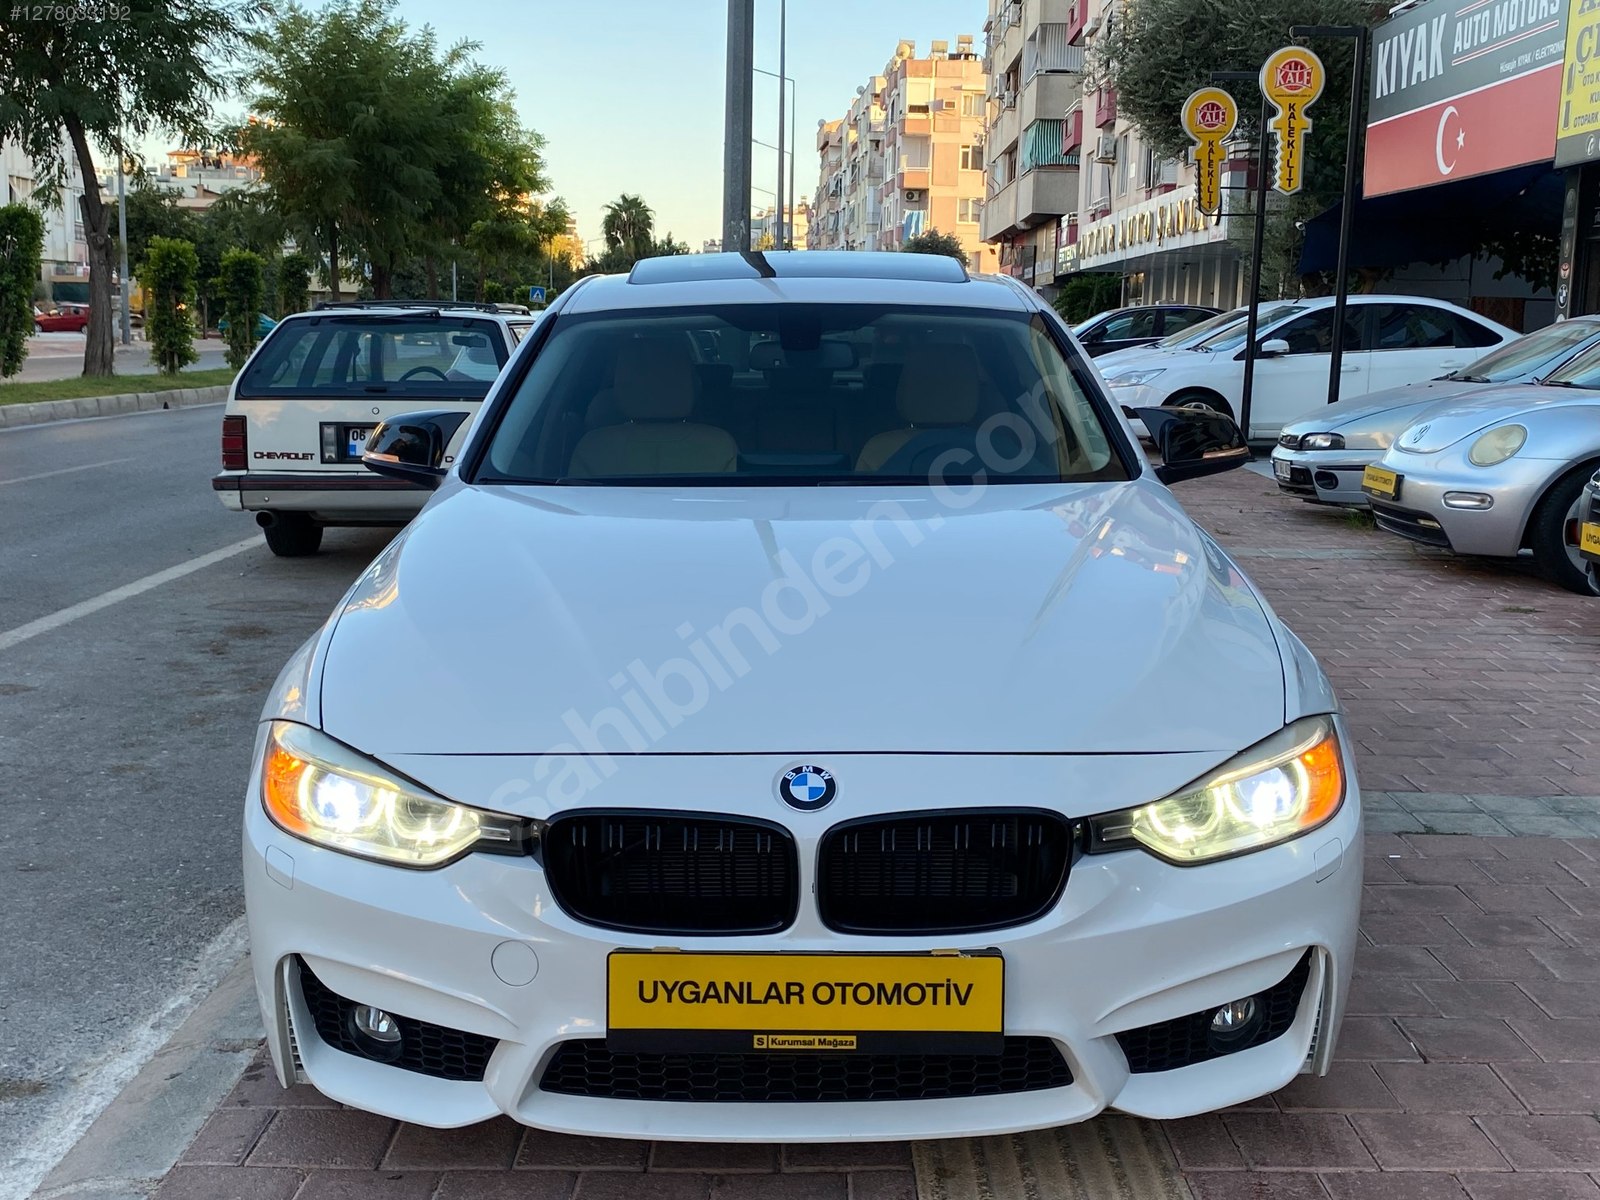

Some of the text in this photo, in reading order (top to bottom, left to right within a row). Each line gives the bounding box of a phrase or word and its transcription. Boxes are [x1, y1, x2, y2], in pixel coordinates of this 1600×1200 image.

[1453, 9, 1490, 55] AUTO
[1375, 13, 1447, 100] KIYAK
[1275, 66, 1313, 88] KALE
[1582, 72, 1595, 87] OTO
[1196, 107, 1227, 126] KALE
[351, 430, 366, 441] 06
[253, 451, 315, 461] CHEVROLET
[784, 765, 832, 780] BMW
[638, 978, 974, 1006] UYGANLAR OTOMOTİV
[770, 1037, 815, 1047] Kurumsal
[818, 1037, 855, 1049] Mağaza
